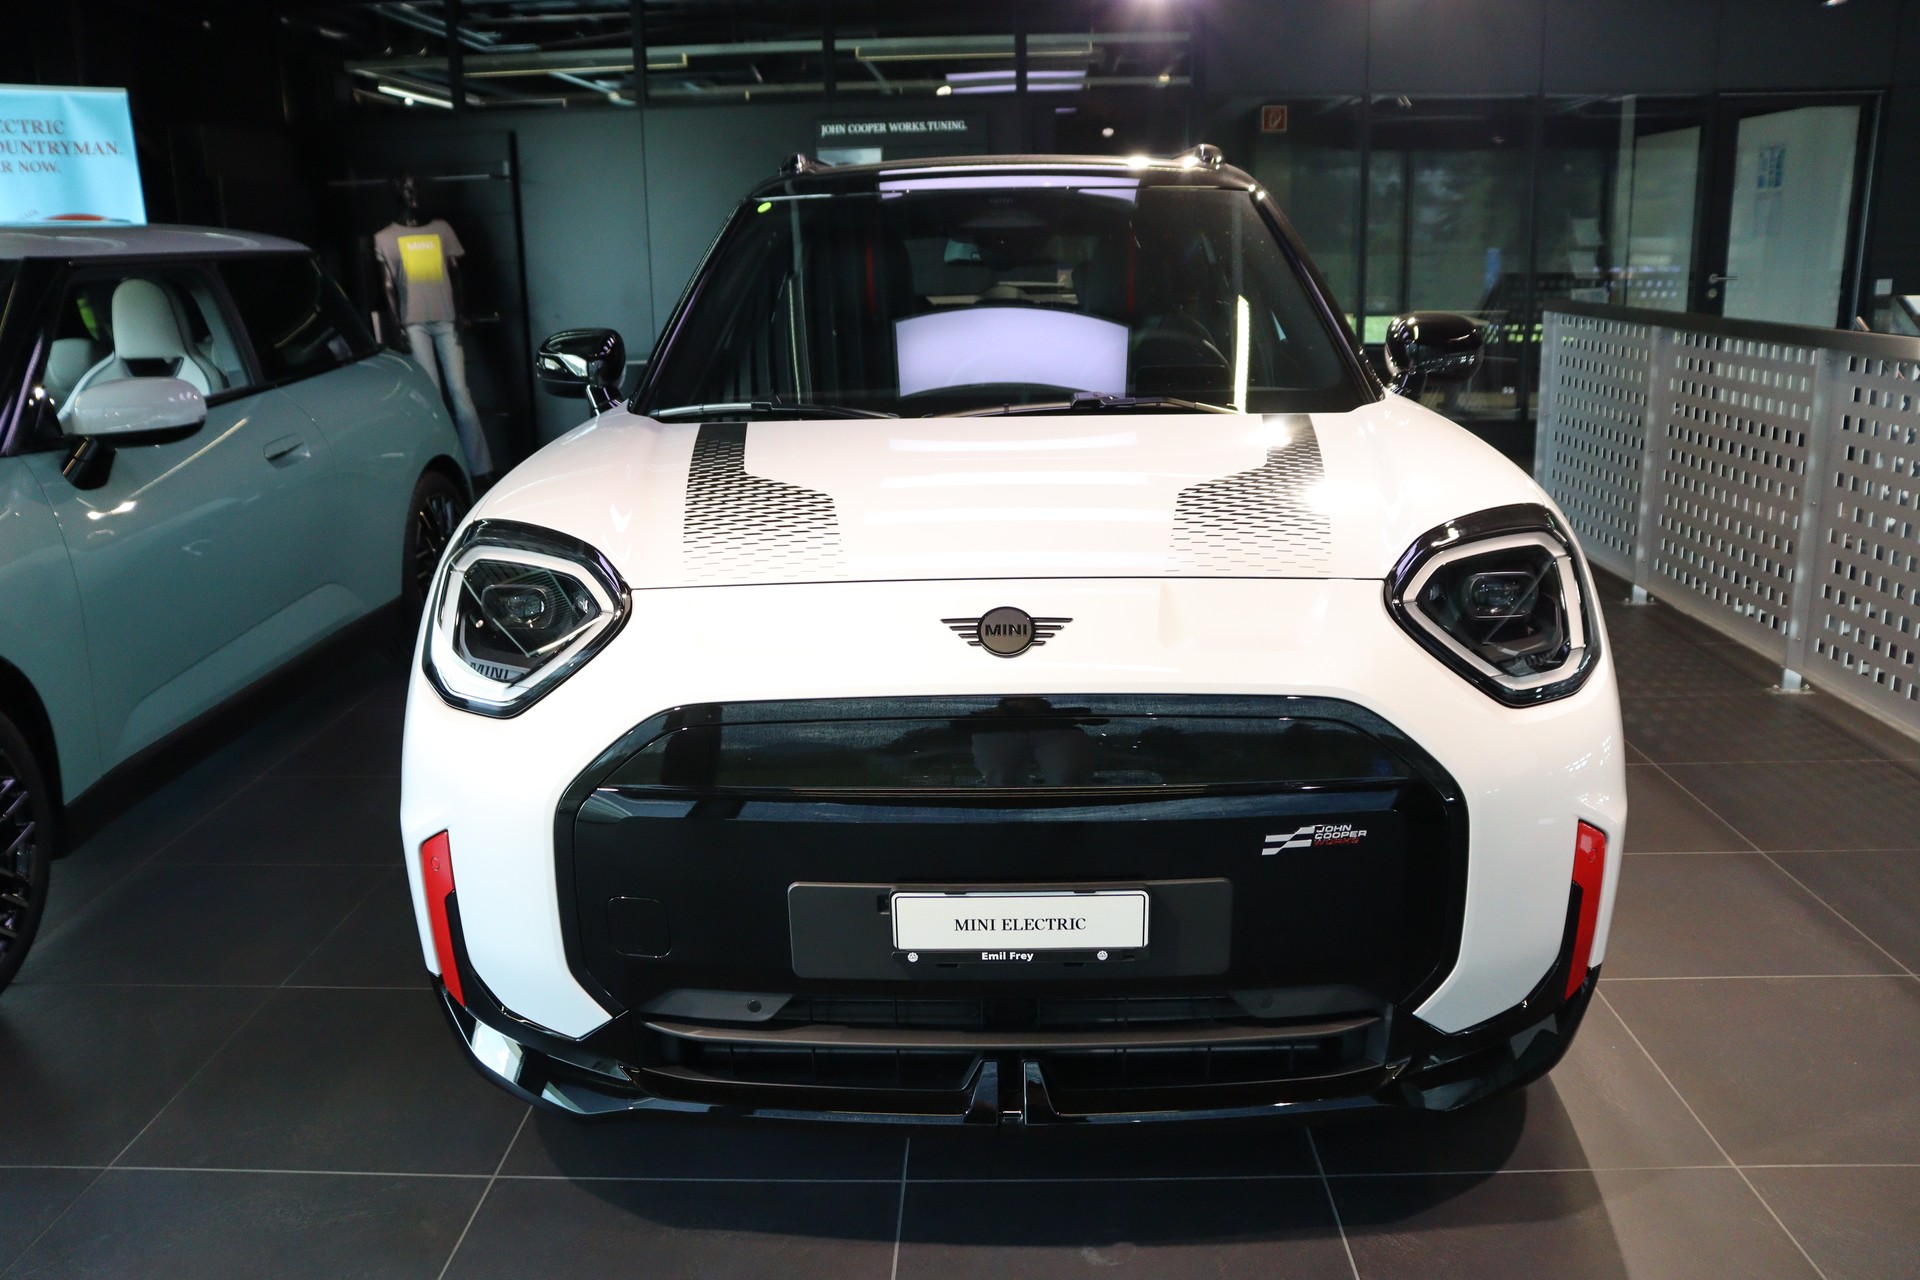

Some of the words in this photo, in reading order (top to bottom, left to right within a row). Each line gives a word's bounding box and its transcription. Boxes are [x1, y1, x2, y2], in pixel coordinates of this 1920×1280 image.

[820, 124, 846, 137] JOHN
[847, 122, 887, 134] COOPER
[985, 623, 1027, 636] MINI
[1316, 824, 1352, 833] JOHN
[1314, 830, 1367, 840] COOPER
[954, 918, 996, 931] MINI
[1001, 917, 1087, 931] ELECTRIC
[981, 951, 1007, 961] Emil
[1009, 951, 1034, 962] Frey
